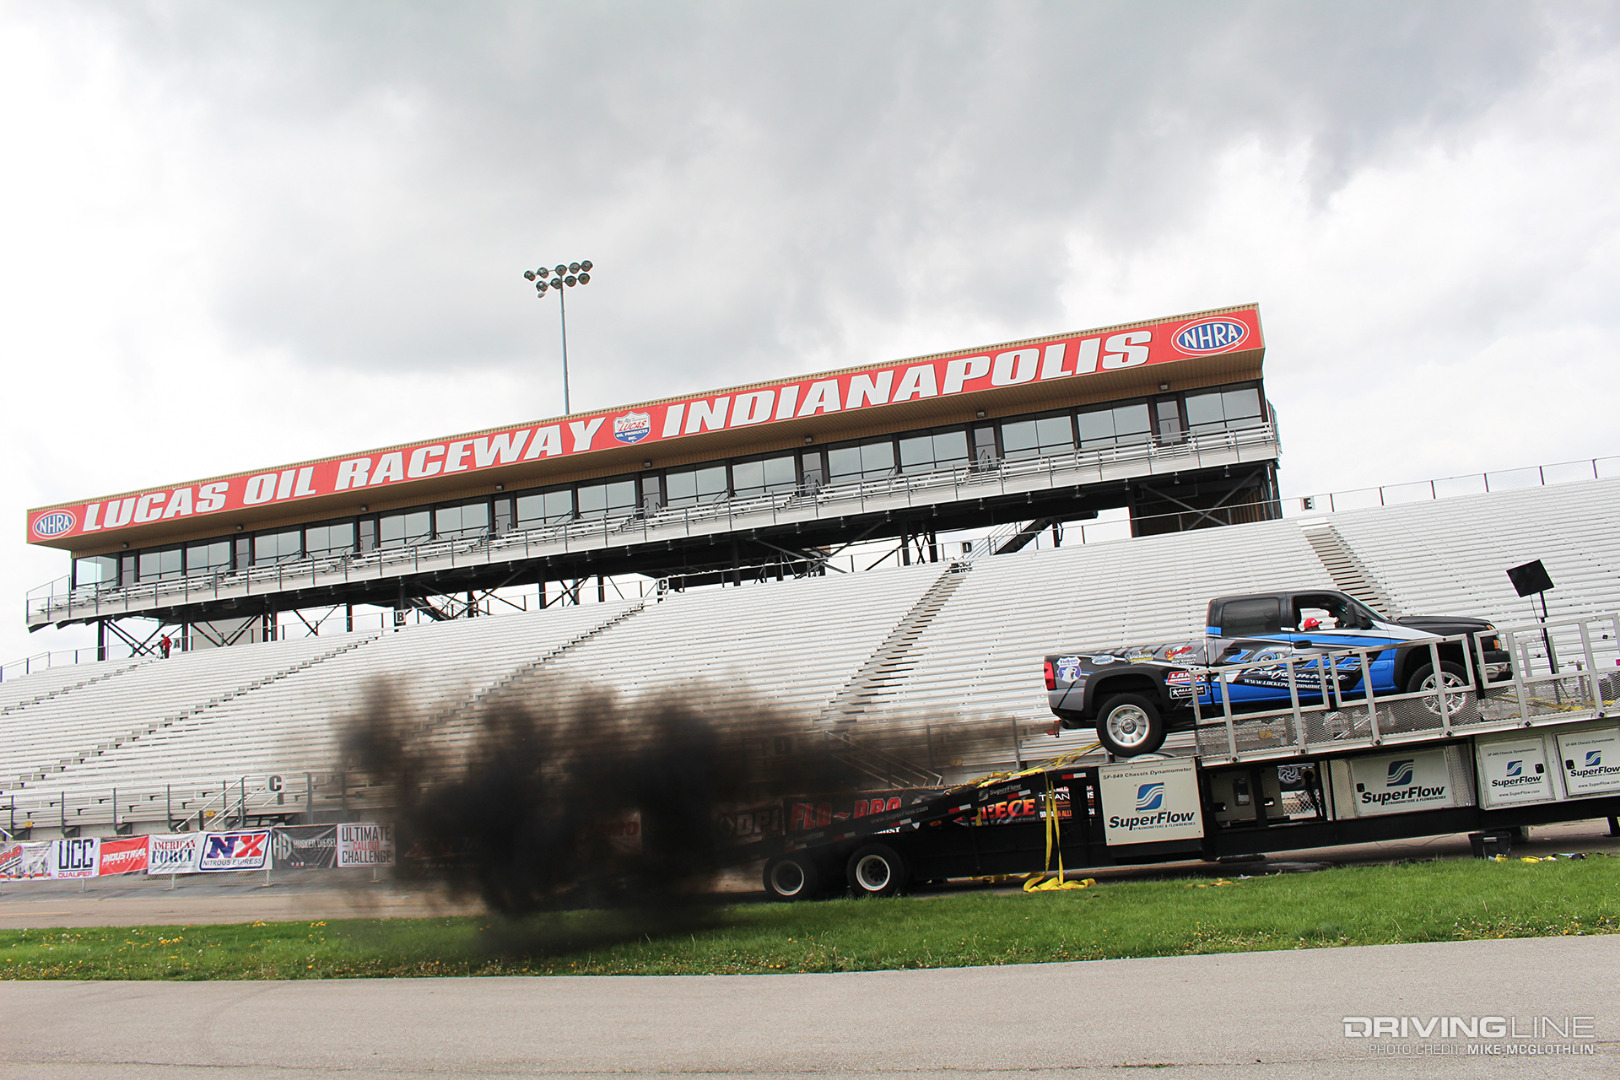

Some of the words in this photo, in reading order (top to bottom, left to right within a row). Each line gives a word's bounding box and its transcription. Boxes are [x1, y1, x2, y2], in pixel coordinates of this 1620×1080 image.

[1184, 321, 1242, 349] NHRA
[37, 515, 72, 535] NHRA
[82, 481, 230, 532] LUCAS
[243, 466, 317, 505] OIL
[334, 416, 607, 491] RACEWAY
[661, 330, 1153, 438] INDIANAPOLIS
[618, 420, 647, 432] LUCAS
[1303, 497, 1313, 510] E
[962, 541, 972, 553] D
[658, 578, 668, 591] C
[397, 611, 405, 623] B
[1150, 767, 1192, 776] Dynamometer
[1570, 766, 1620, 779] SuperFlow
[268, 775, 282, 792] C
[1491, 776, 1542, 788] SuperFlow
[1361, 786, 1446, 806] SuperFlow
[1108, 811, 1195, 831] SuperFlow
[341, 826, 392, 842] ULTIMATE
[153, 840, 196, 850] AMERICAN
[206, 834, 268, 859] NX
[293, 838, 316, 849] HUSKER
[317, 837, 337, 848] DIESEL
[353, 840, 380, 851] CALLOUT
[58, 839, 94, 870] UCC
[152, 848, 195, 864] FORCE
[342, 849, 392, 863] CHALLENGE
[58, 870, 93, 879] QUALIFIER
